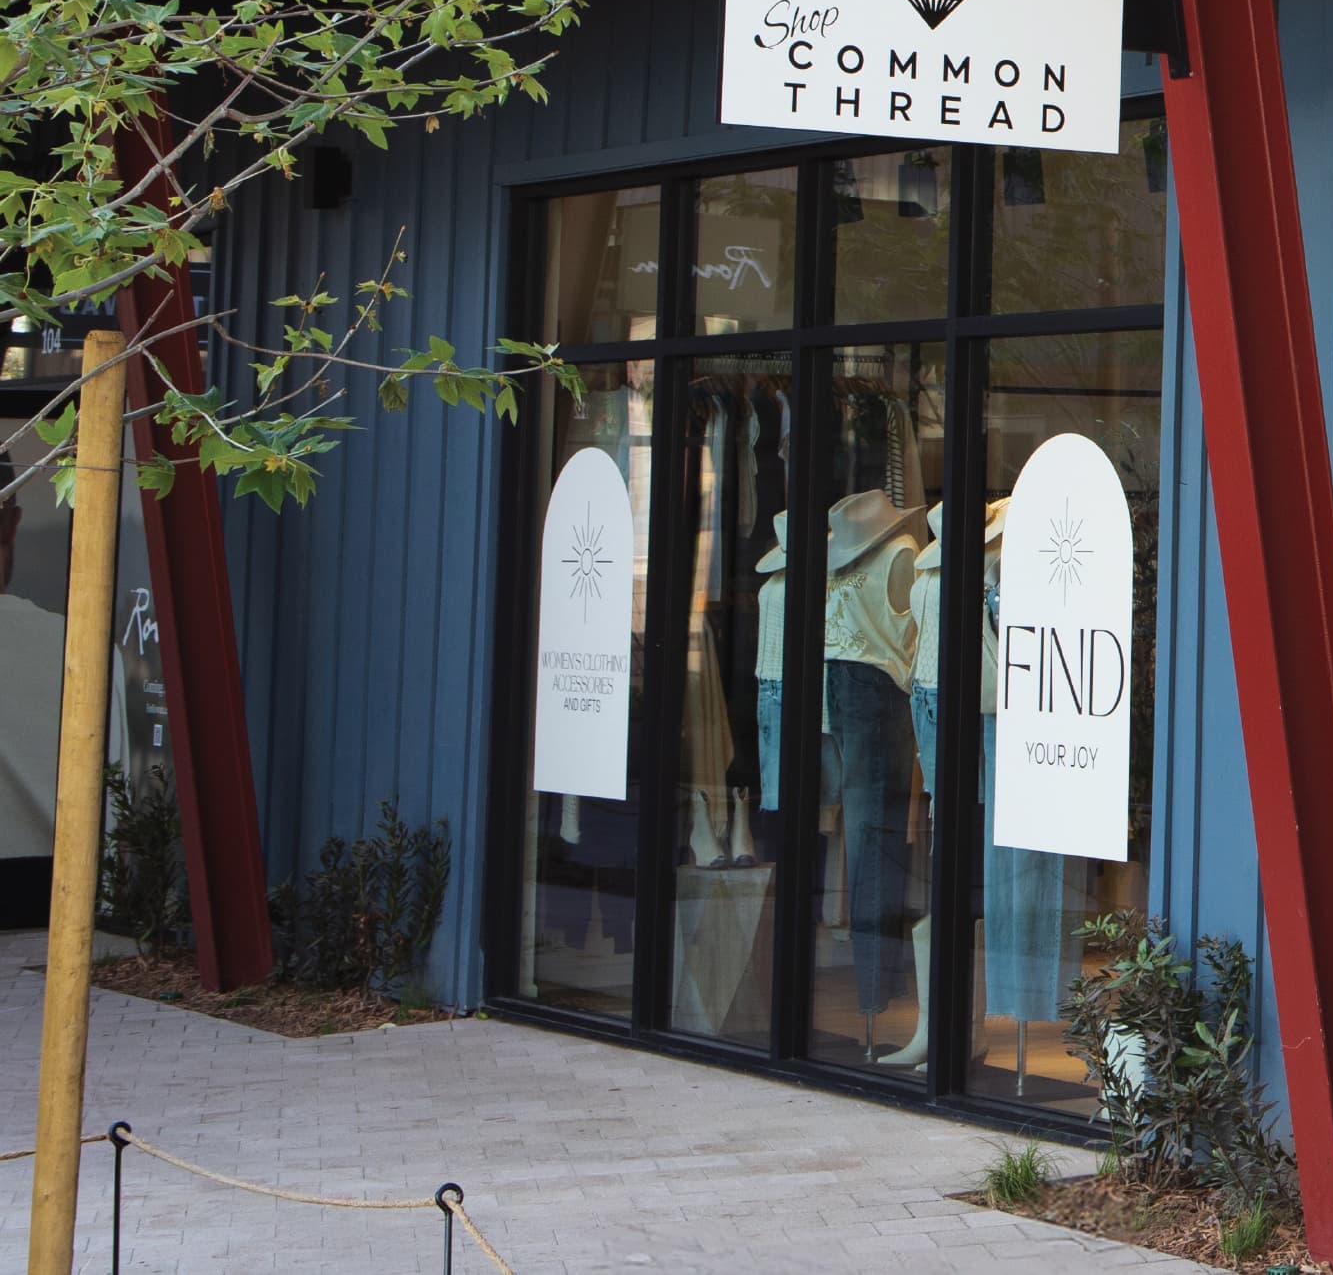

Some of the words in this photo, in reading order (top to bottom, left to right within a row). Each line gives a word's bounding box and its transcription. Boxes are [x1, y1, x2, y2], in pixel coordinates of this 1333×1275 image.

[788, 39, 1066, 92] COMMON
[783, 81, 1066, 133] THREAD
[41, 327, 61, 354] 104
[583, 653, 628, 674] CLOTHING
[1004, 624, 1125, 717] FIND
[552, 674, 614, 695] ACCESSORIES
[563, 697, 579, 711] AND
[580, 698, 601, 713] GIFTS
[1025, 741, 1066, 767] YOUR
[1070, 745, 1099, 770] JOY
